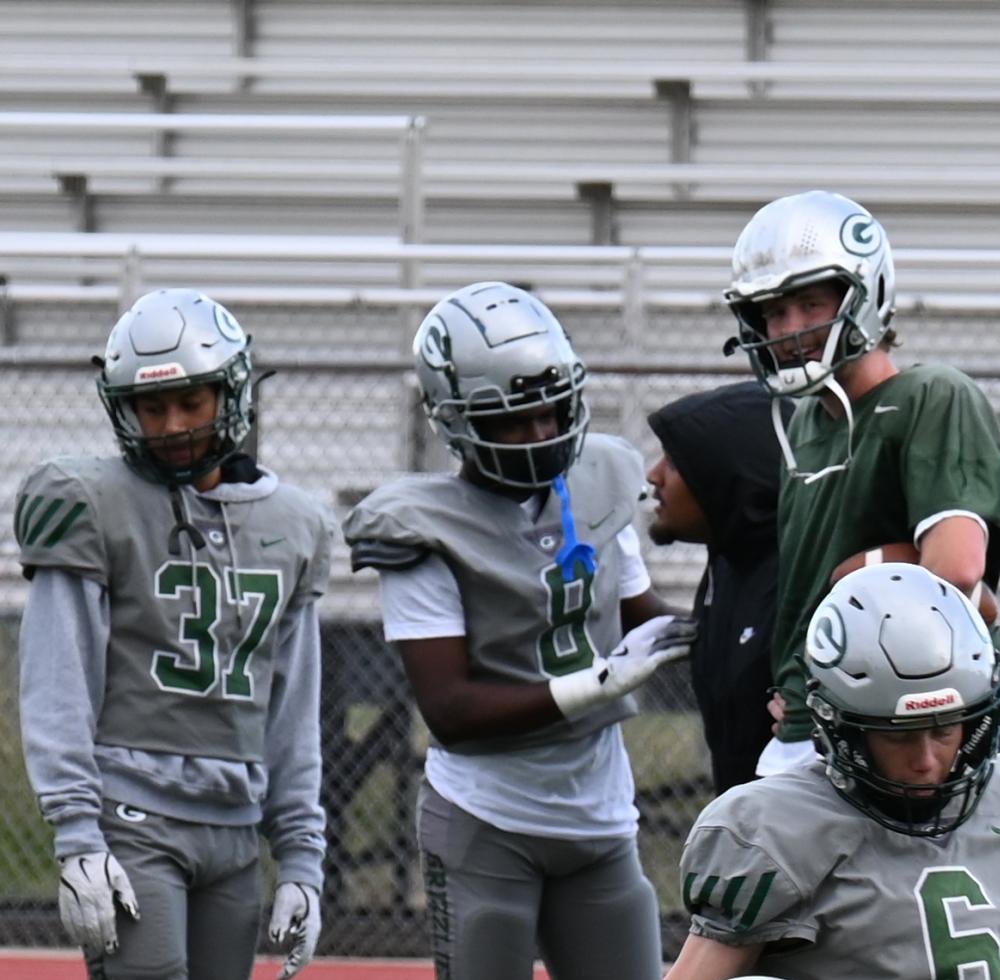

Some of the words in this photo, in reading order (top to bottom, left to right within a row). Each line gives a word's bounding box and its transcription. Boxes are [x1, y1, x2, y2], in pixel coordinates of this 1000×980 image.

[839, 213, 881, 257] G
[151, 560, 284, 700] 37
[536, 562, 600, 680] 8
[807, 603, 847, 669] G
[905, 694, 956, 710] Riddell
[116, 803, 147, 822] G
